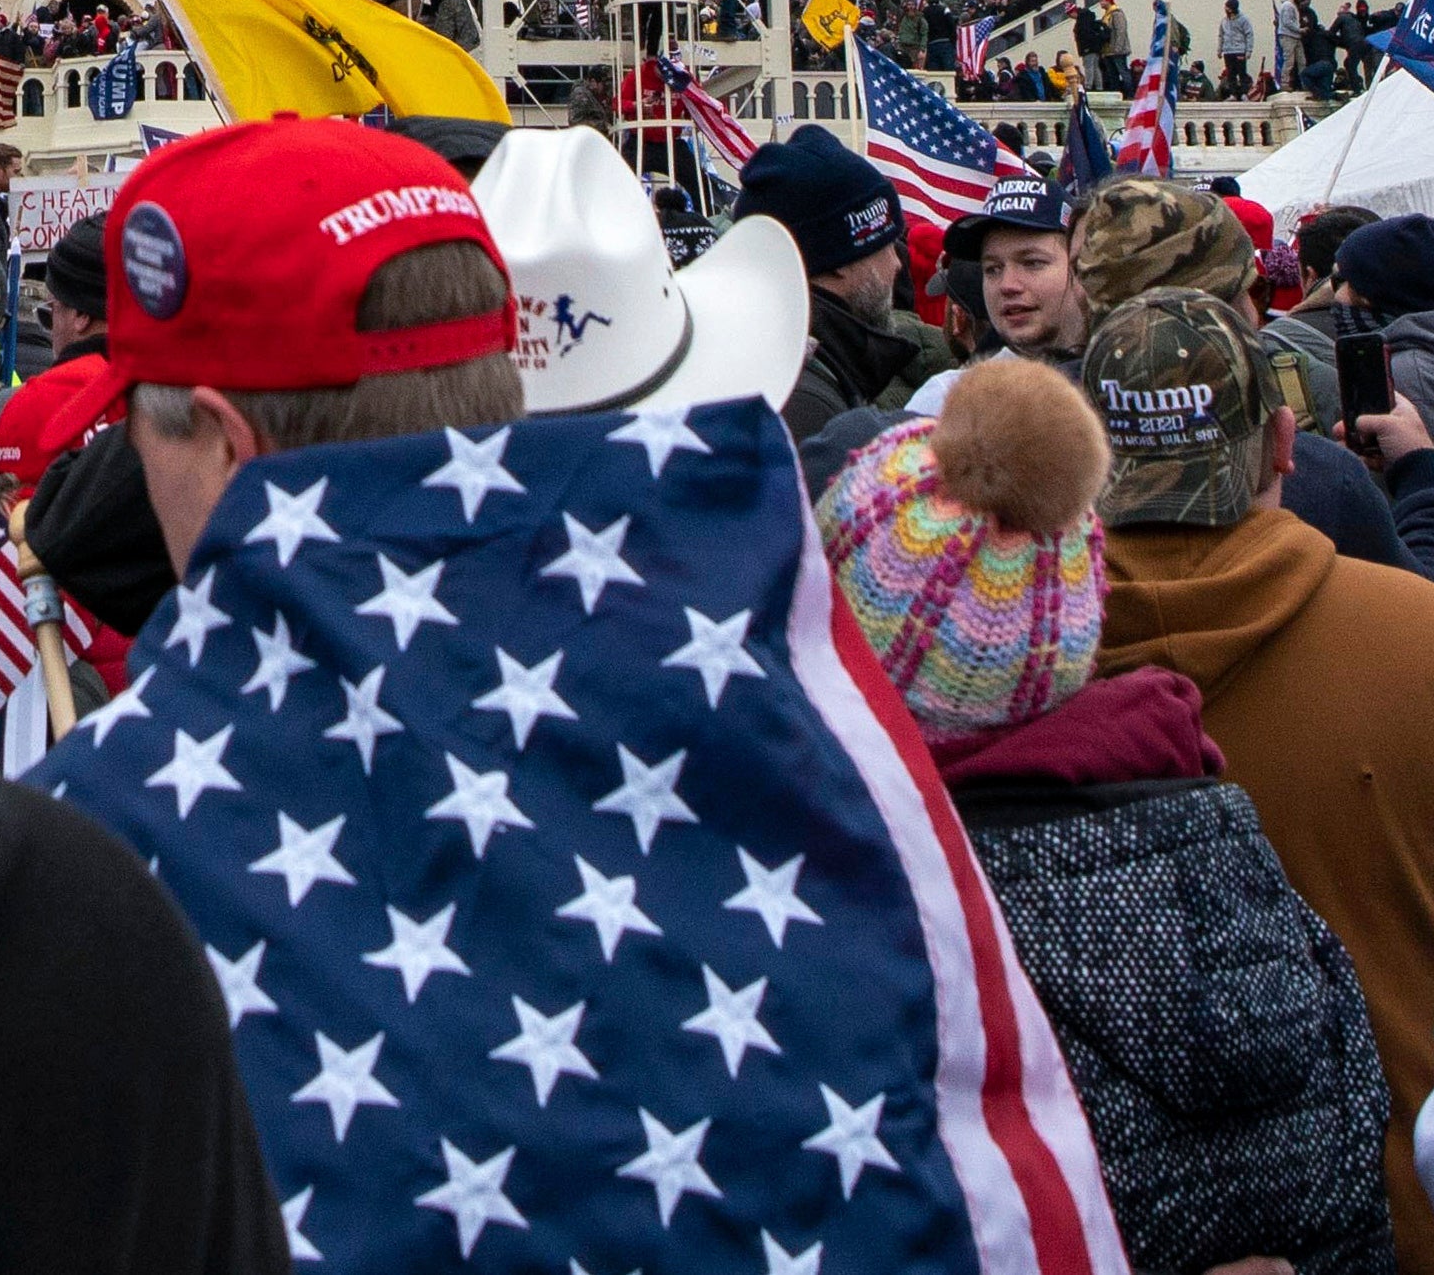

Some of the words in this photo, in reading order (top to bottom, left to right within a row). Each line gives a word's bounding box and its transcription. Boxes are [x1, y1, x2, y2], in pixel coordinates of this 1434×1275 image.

[998, 197, 1037, 213] AGAIN
[1100, 379, 1212, 418] Trump
[1138, 415, 1185, 432] 2020
[1125, 435, 1157, 446] MORE
[1161, 432, 1191, 445] BULL
[1195, 429, 1219, 442] SHIT
